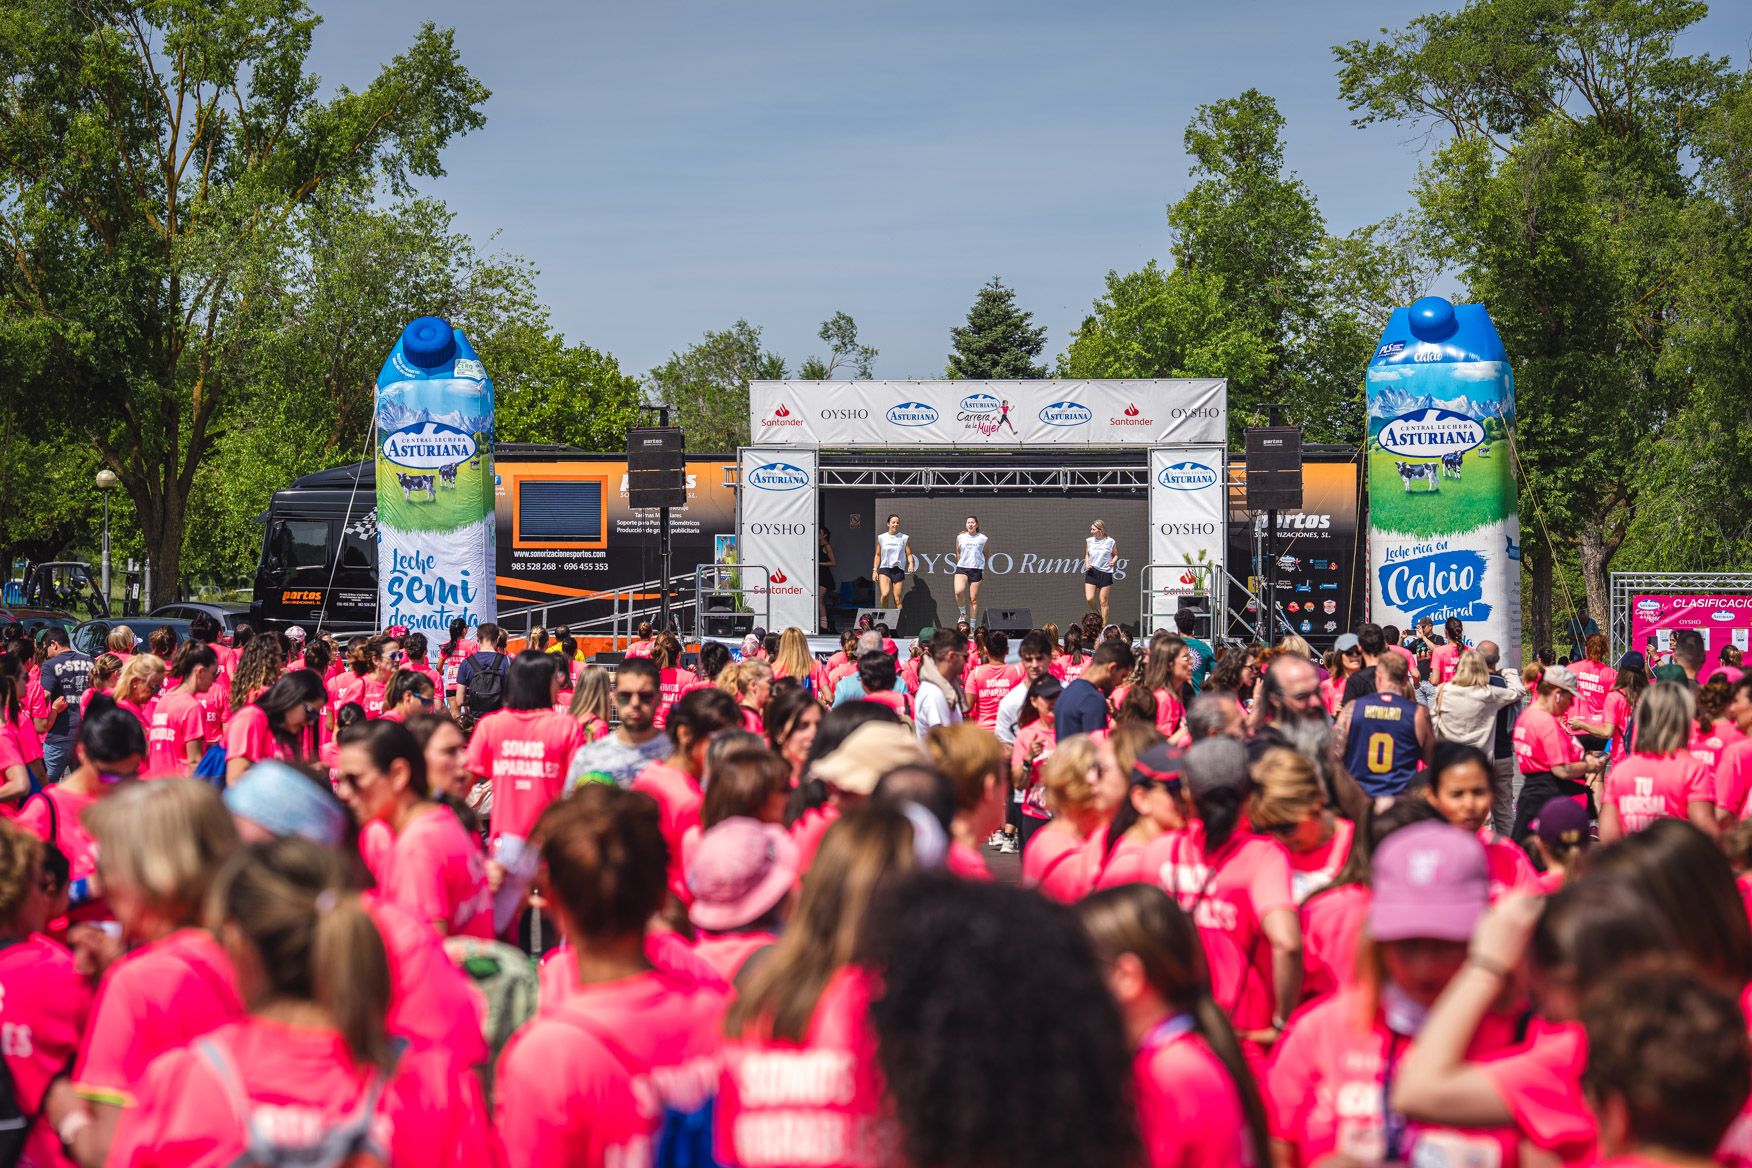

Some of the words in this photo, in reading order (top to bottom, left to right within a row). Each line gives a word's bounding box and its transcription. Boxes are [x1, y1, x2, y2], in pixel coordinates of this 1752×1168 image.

[964, 400, 998, 409] ASTURIANA
[820, 409, 868, 420] OYSHO
[890, 411, 935, 421] ASTURIANA
[956, 411, 991, 423] Carrera
[1042, 410, 1091, 421] ASTURIANA
[1171, 407, 1219, 419] OYSHO
[761, 418, 803, 427] Santander
[1110, 417, 1153, 426] Santander
[976, 423, 1001, 437] Mujer
[1384, 428, 1477, 446] ASTURIANA
[388, 439, 470, 457] ASTURIANA
[753, 472, 805, 484] ASTURIANA
[1163, 472, 1213, 484] ASTURIANA
[616, 519, 637, 528] Soporte
[751, 523, 806, 535] OYSHO
[1161, 522, 1215, 535] OYSHO
[513, 549, 606, 560] www.sonorizacionesportos.com
[1384, 547, 1410, 563] Leche
[1413, 543, 1433, 555] rica
[1436, 541, 1448, 551] en
[390, 548, 437, 577] Leche
[511, 563, 526, 571] 983
[526, 563, 541, 571] 528
[541, 563, 556, 571] 268
[563, 563, 578, 571] 696
[579, 563, 593, 571] 455
[594, 563, 609, 571] 353
[1018, 553, 1130, 580] Runng
[387, 569, 478, 608] semi
[1387, 562, 1474, 606] Calcio
[281, 591, 322, 601] portos
[986, 678, 1010, 688] SOMOS
[501, 739, 545, 759] SOMOS
[1367, 732, 1395, 774] 0
